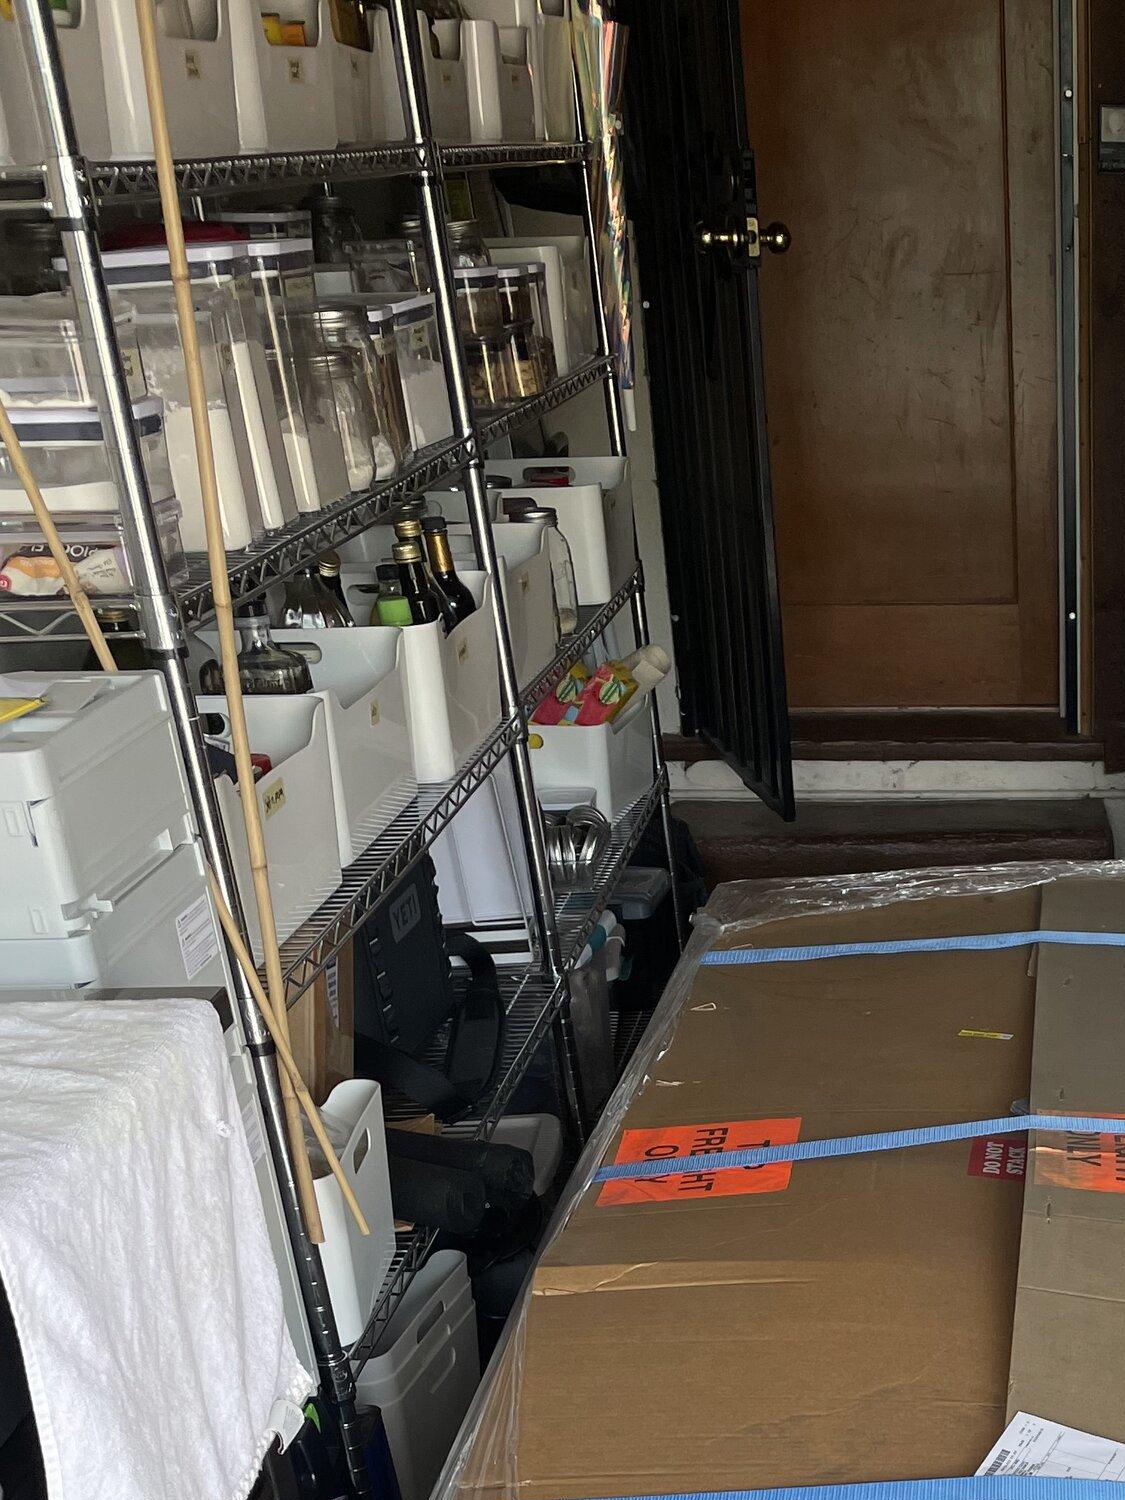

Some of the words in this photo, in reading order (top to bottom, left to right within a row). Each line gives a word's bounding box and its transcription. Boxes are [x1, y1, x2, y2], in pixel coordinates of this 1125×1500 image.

[392, 894, 417, 930] YETI
[985, 1141, 1004, 1160] NOT
[1006, 1146, 1026, 1175] STACK
[983, 1161, 1001, 1175] DO
